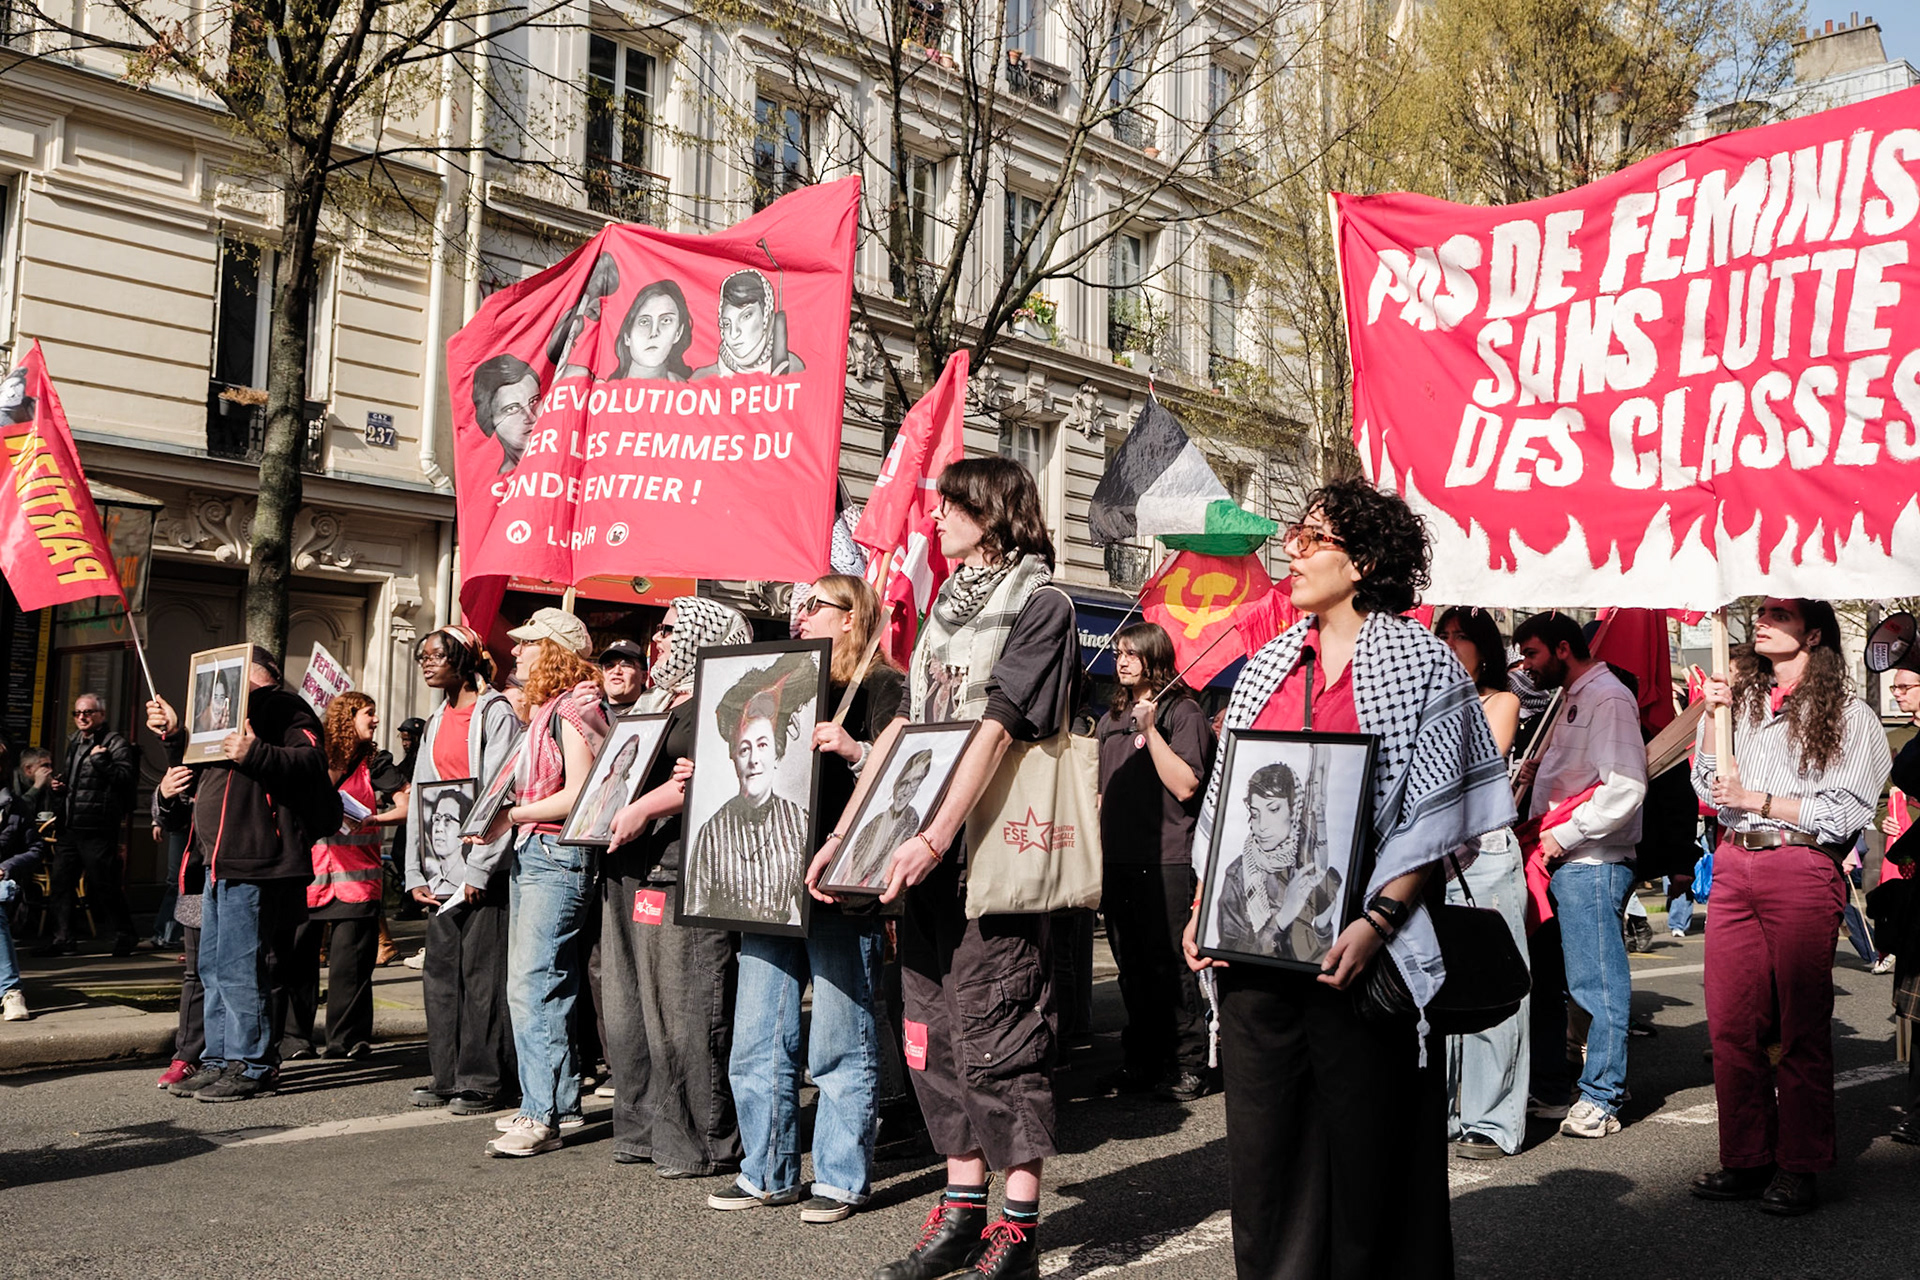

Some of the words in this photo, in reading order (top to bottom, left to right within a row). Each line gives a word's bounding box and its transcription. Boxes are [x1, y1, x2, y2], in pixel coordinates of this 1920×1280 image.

[1367, 234, 1483, 331] PAS
[1483, 209, 1584, 318] DE
[1472, 287, 1663, 407] SANS
[1679, 240, 1909, 377] LUTTE
[731, 382, 801, 414] PEUT
[366, 425, 395, 445] 237
[1444, 403, 1585, 491] DES
[1609, 348, 1920, 491] CLASSES
[569, 429, 610, 461] LES
[616, 431, 745, 461] FEMMES
[753, 432, 794, 461] DU
[585, 474, 683, 504] ENTIER
[1003, 827, 1029, 843] FSE
